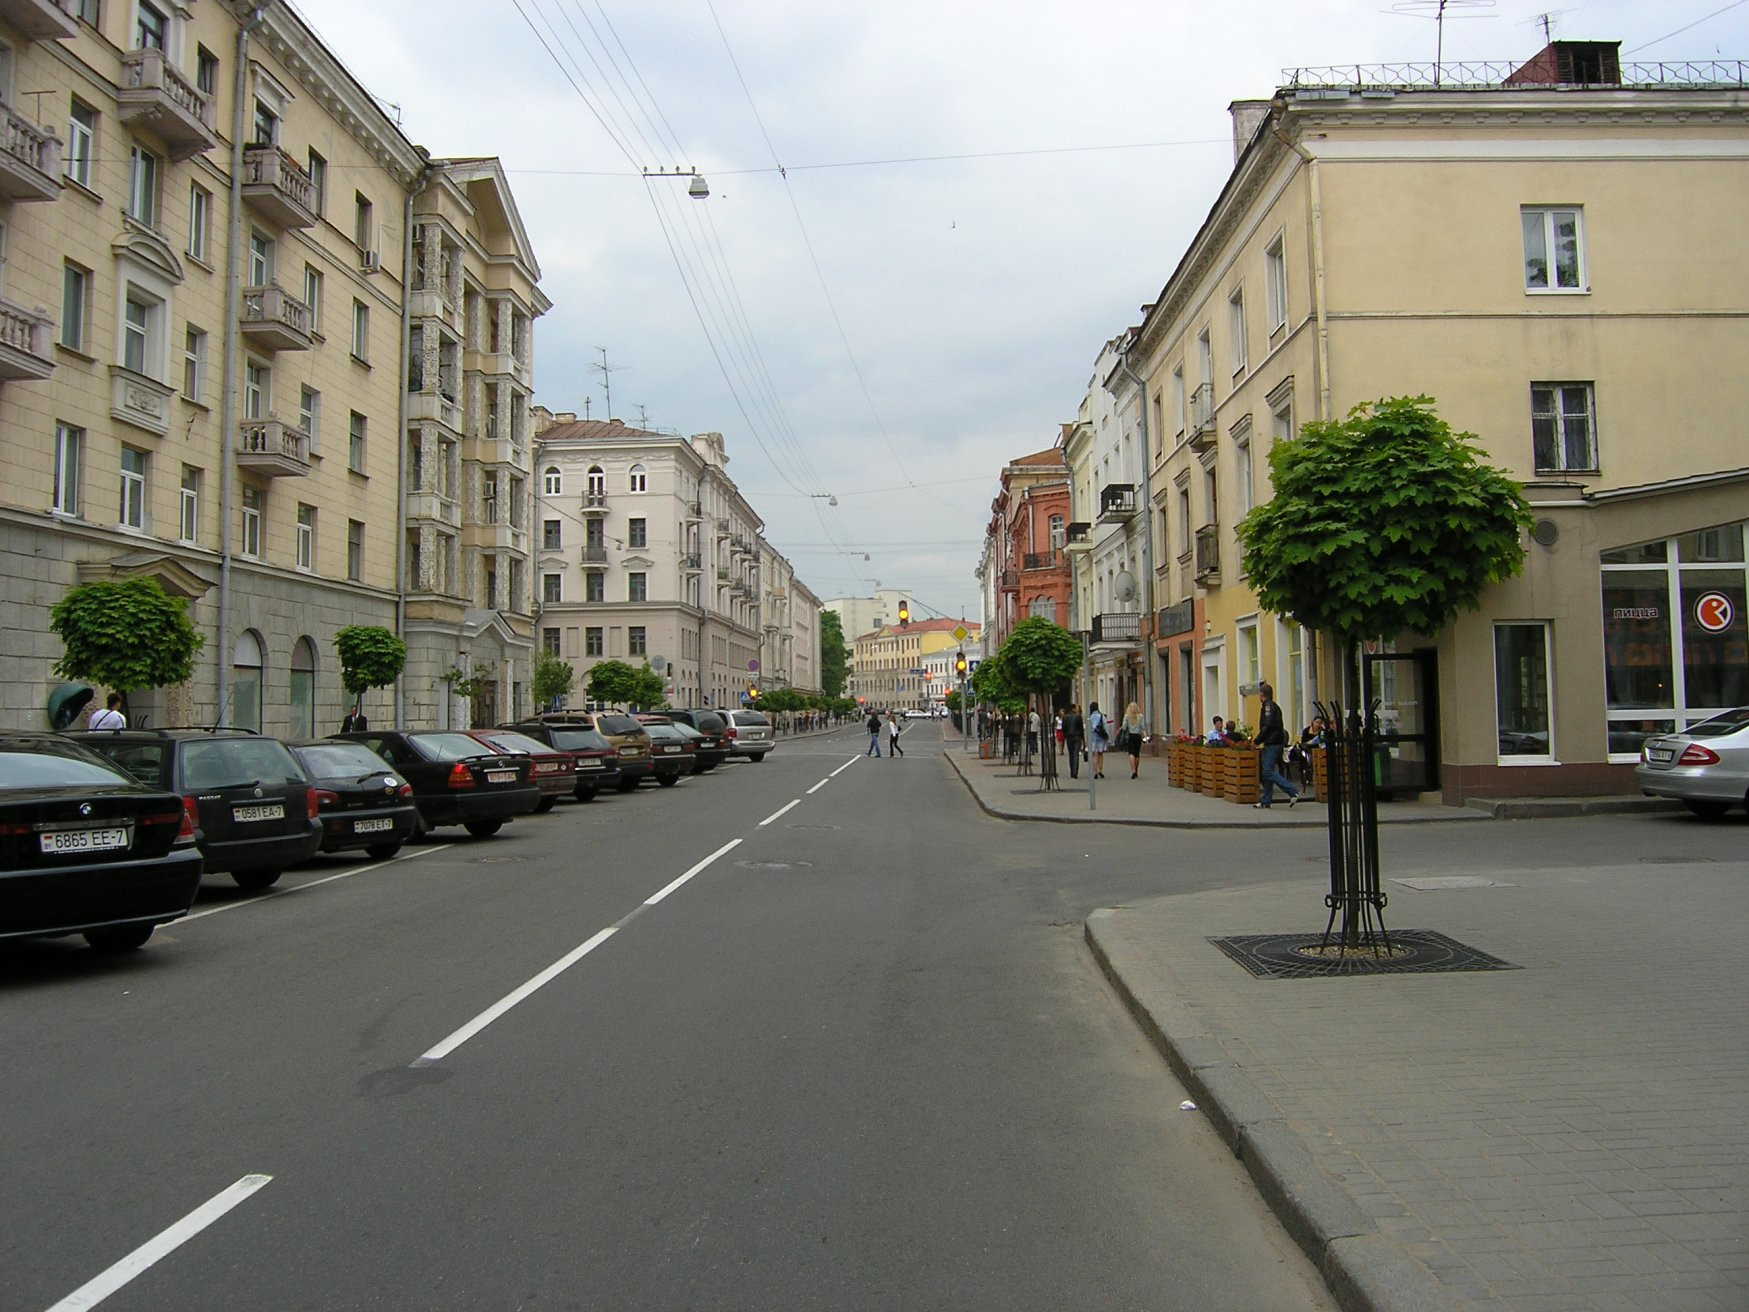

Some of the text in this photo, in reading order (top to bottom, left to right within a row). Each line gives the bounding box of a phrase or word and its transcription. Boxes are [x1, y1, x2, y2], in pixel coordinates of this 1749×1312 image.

[1613, 608, 1659, 619] пицца
[241, 808, 261, 819] 0581
[55, 830, 123, 848] 6865 EE-7
